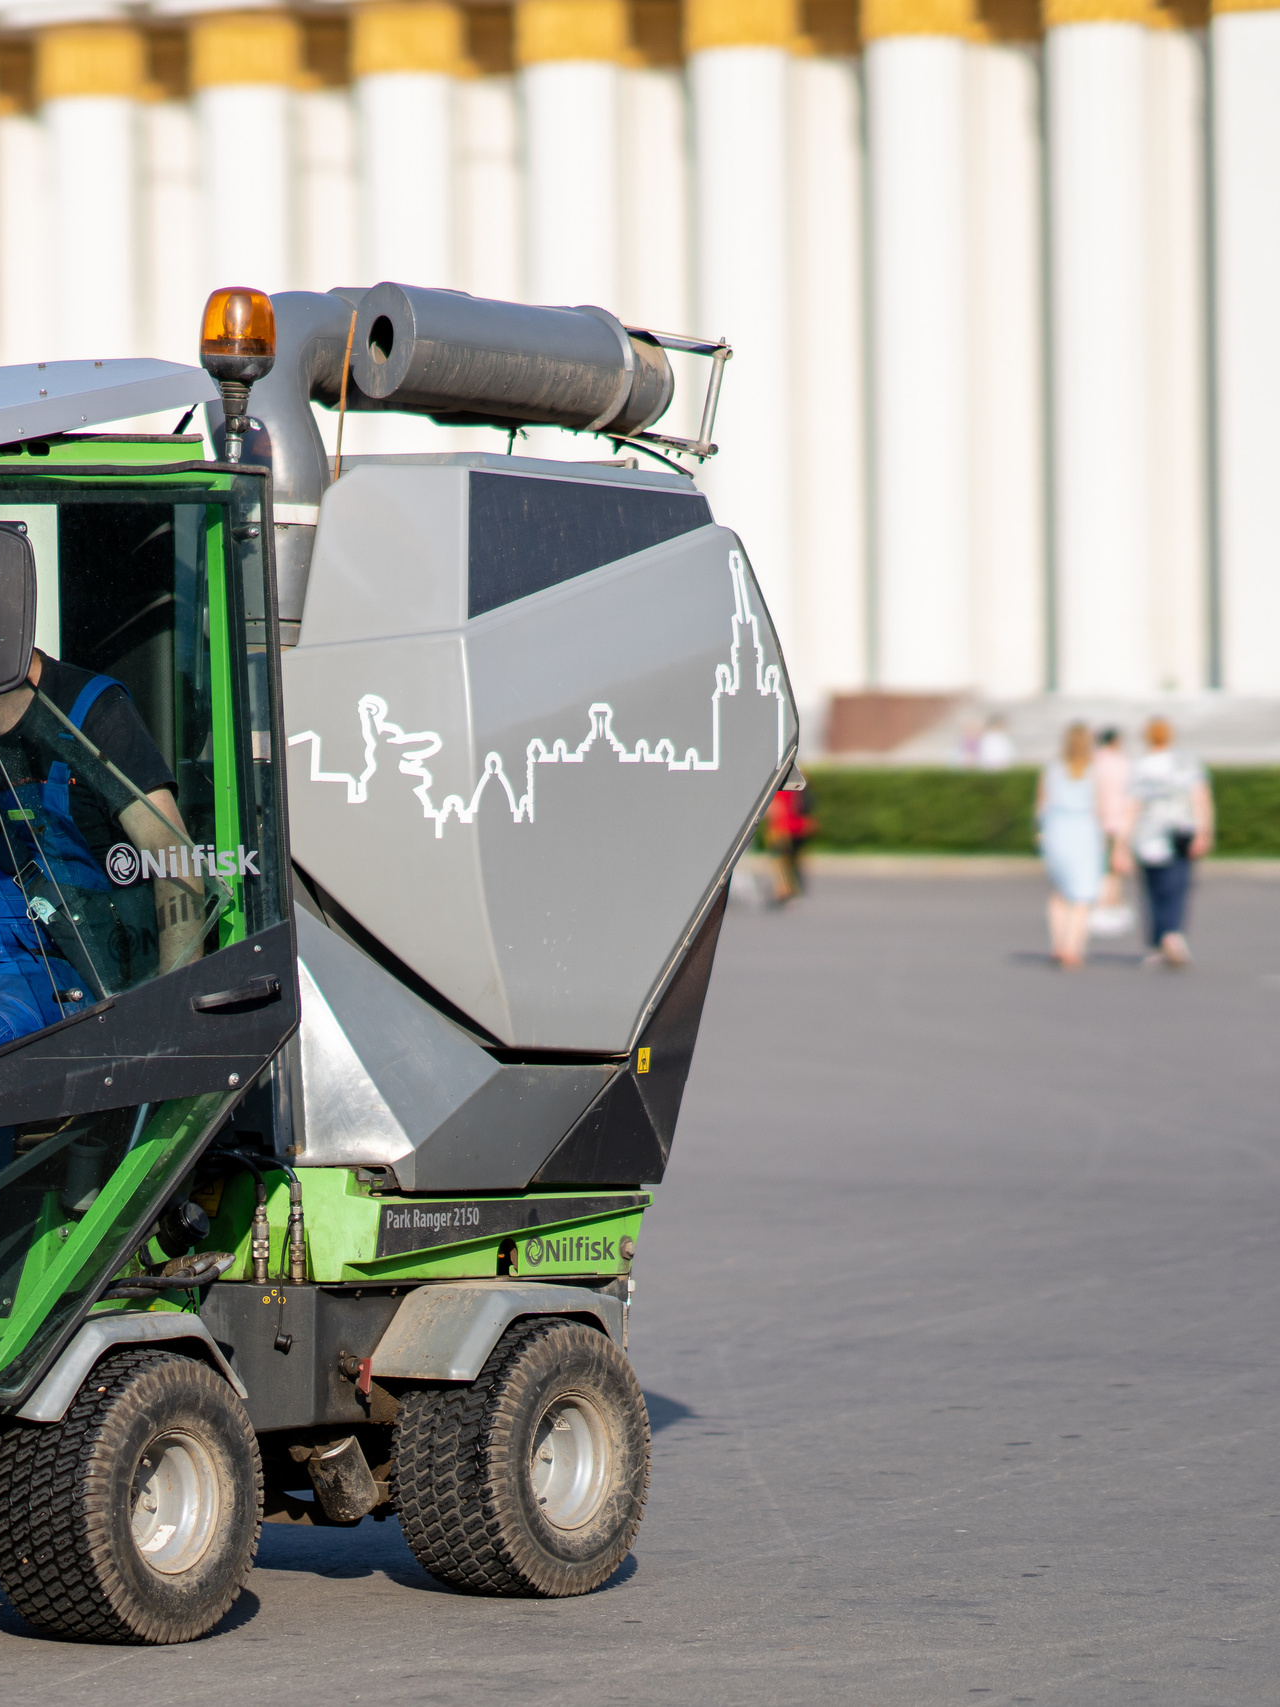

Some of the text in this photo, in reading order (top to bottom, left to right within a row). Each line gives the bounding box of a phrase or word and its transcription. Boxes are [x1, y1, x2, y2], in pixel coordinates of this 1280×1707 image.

[140, 844, 261, 879] Nilfisk
[386, 1207, 480, 1232] Park Ranger 2150
[545, 1236, 615, 1262] Nilfisk
